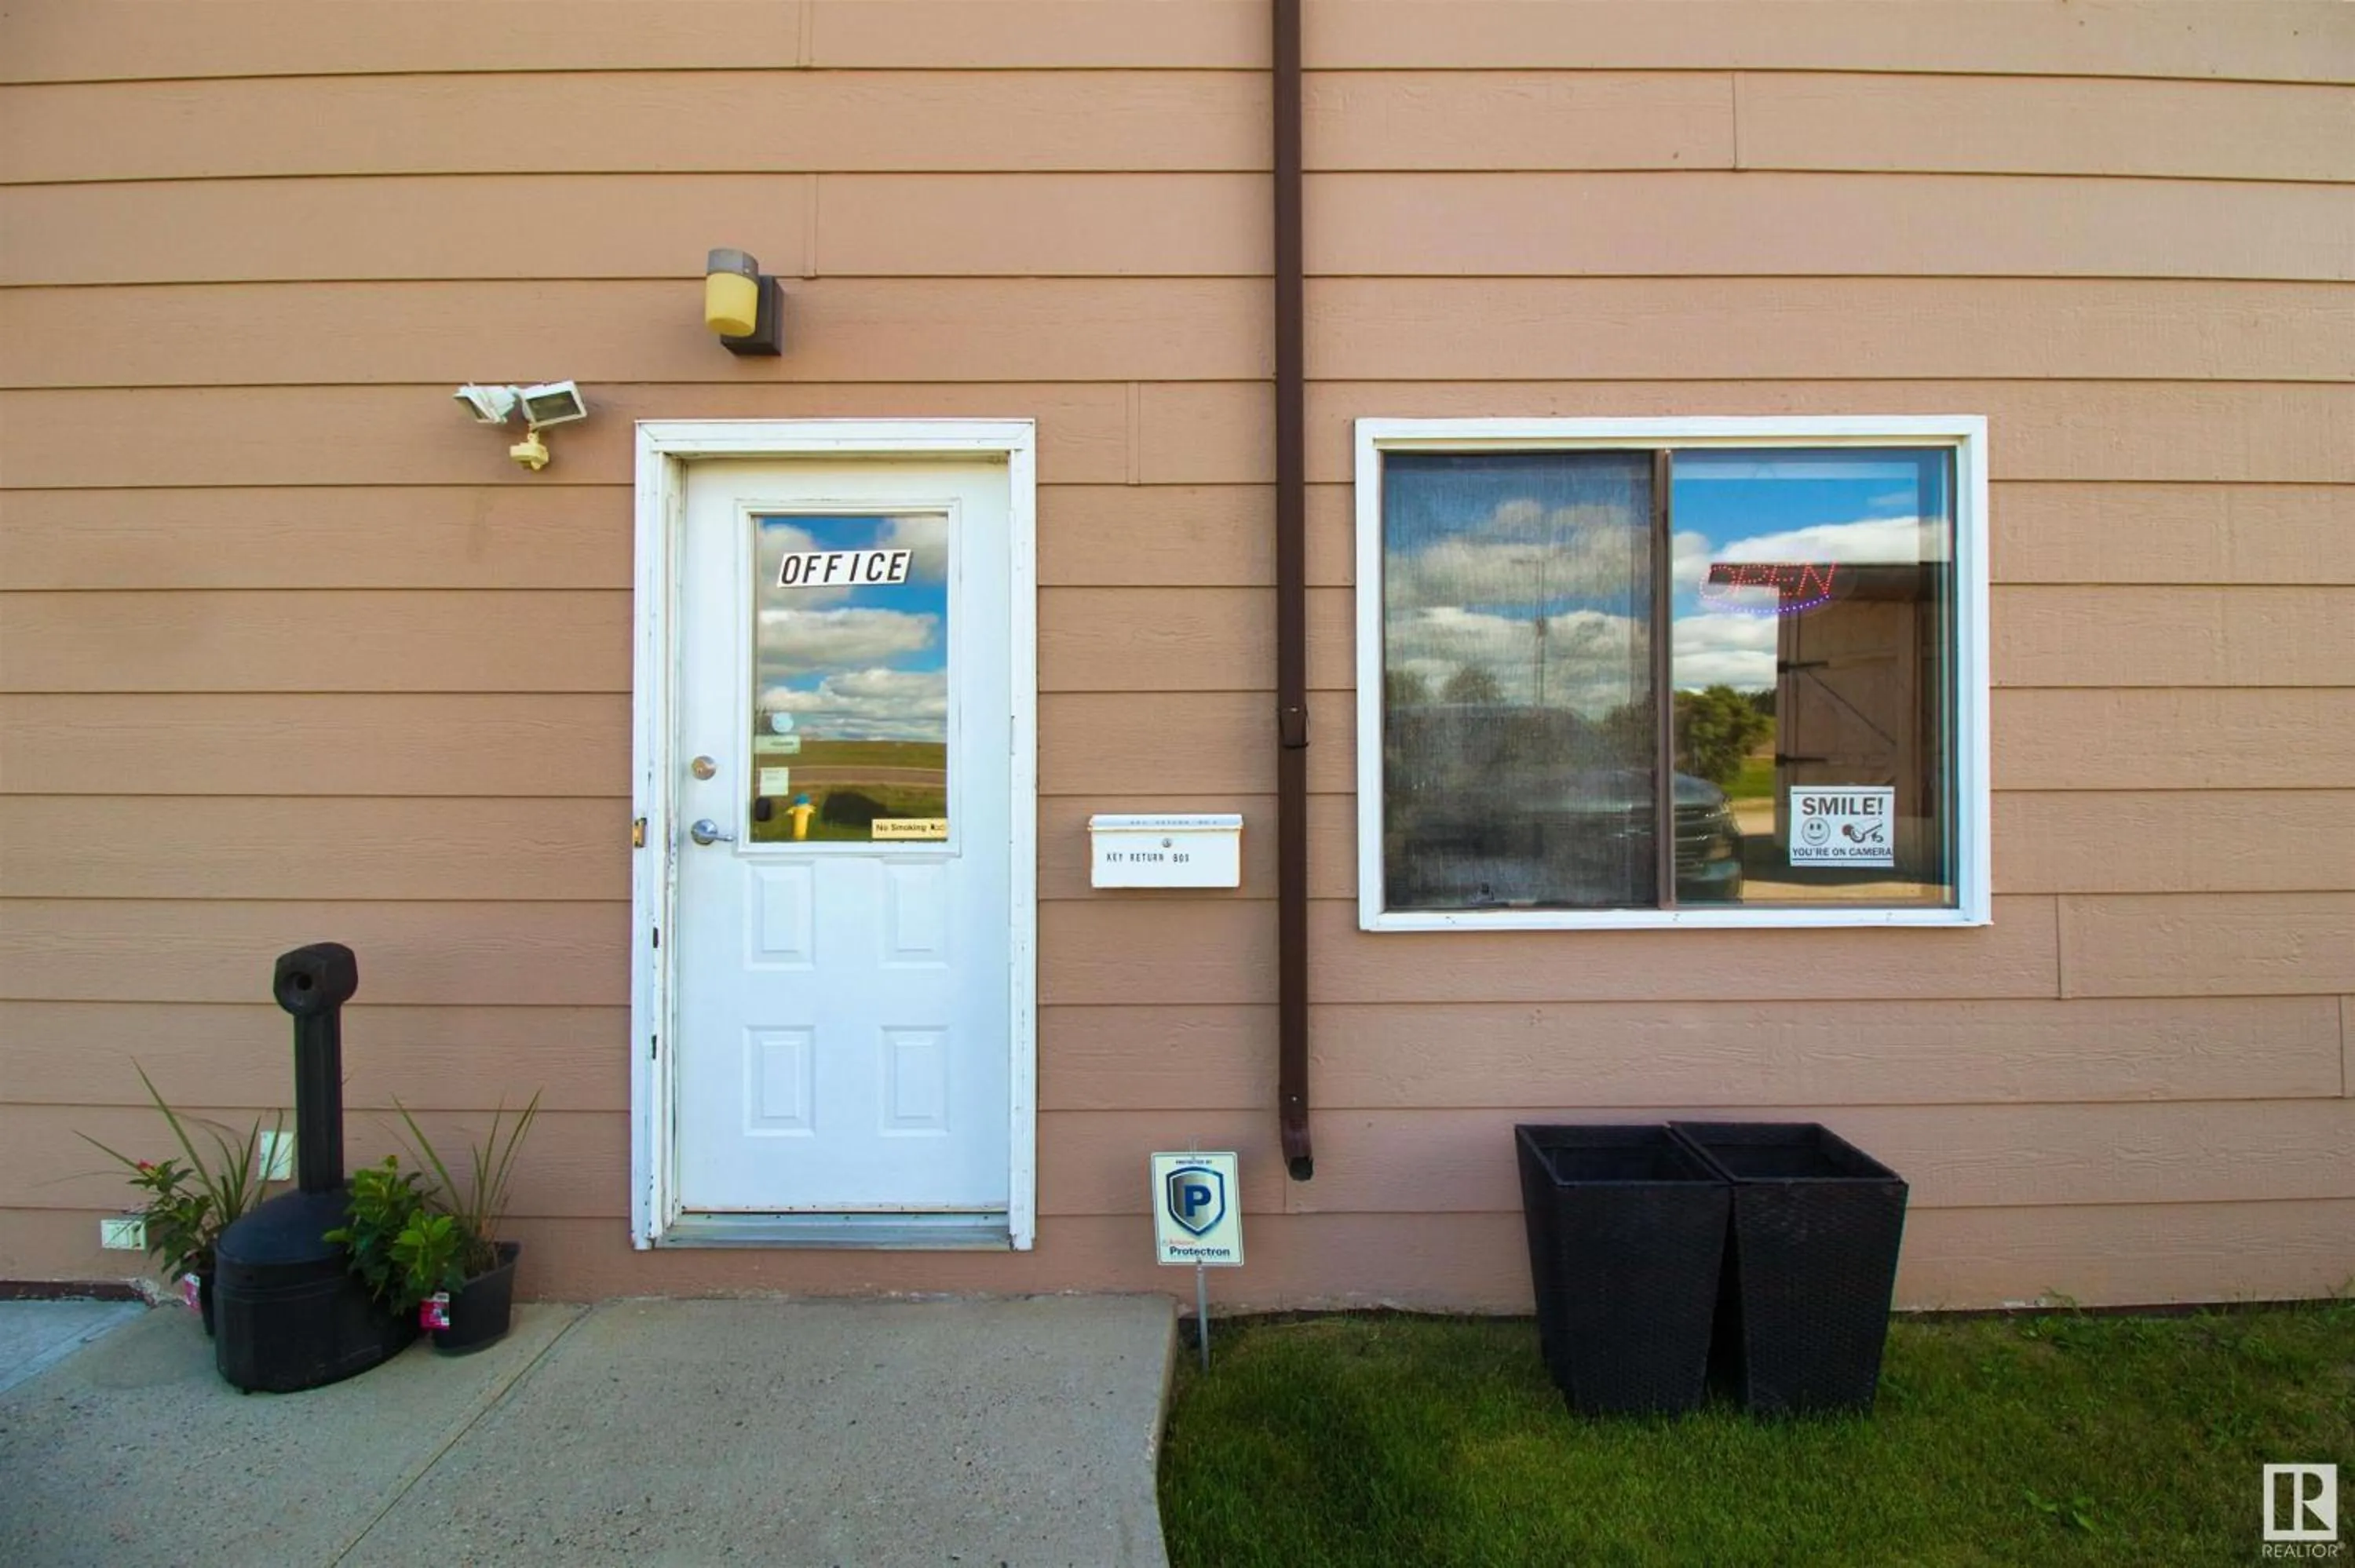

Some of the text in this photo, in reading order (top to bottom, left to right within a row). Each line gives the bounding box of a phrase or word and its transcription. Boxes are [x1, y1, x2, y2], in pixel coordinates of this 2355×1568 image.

[781, 552, 907, 585] OFFICE
[1699, 560, 1838, 600] OPEN
[1802, 797, 1883, 815] SMILE!
[876, 823, 927, 833] No Smoking
[1793, 848, 1893, 856] YOU'RE ON CAMERA
[1185, 1185, 1211, 1217] P
[1169, 1246, 1230, 1256] Protectron
